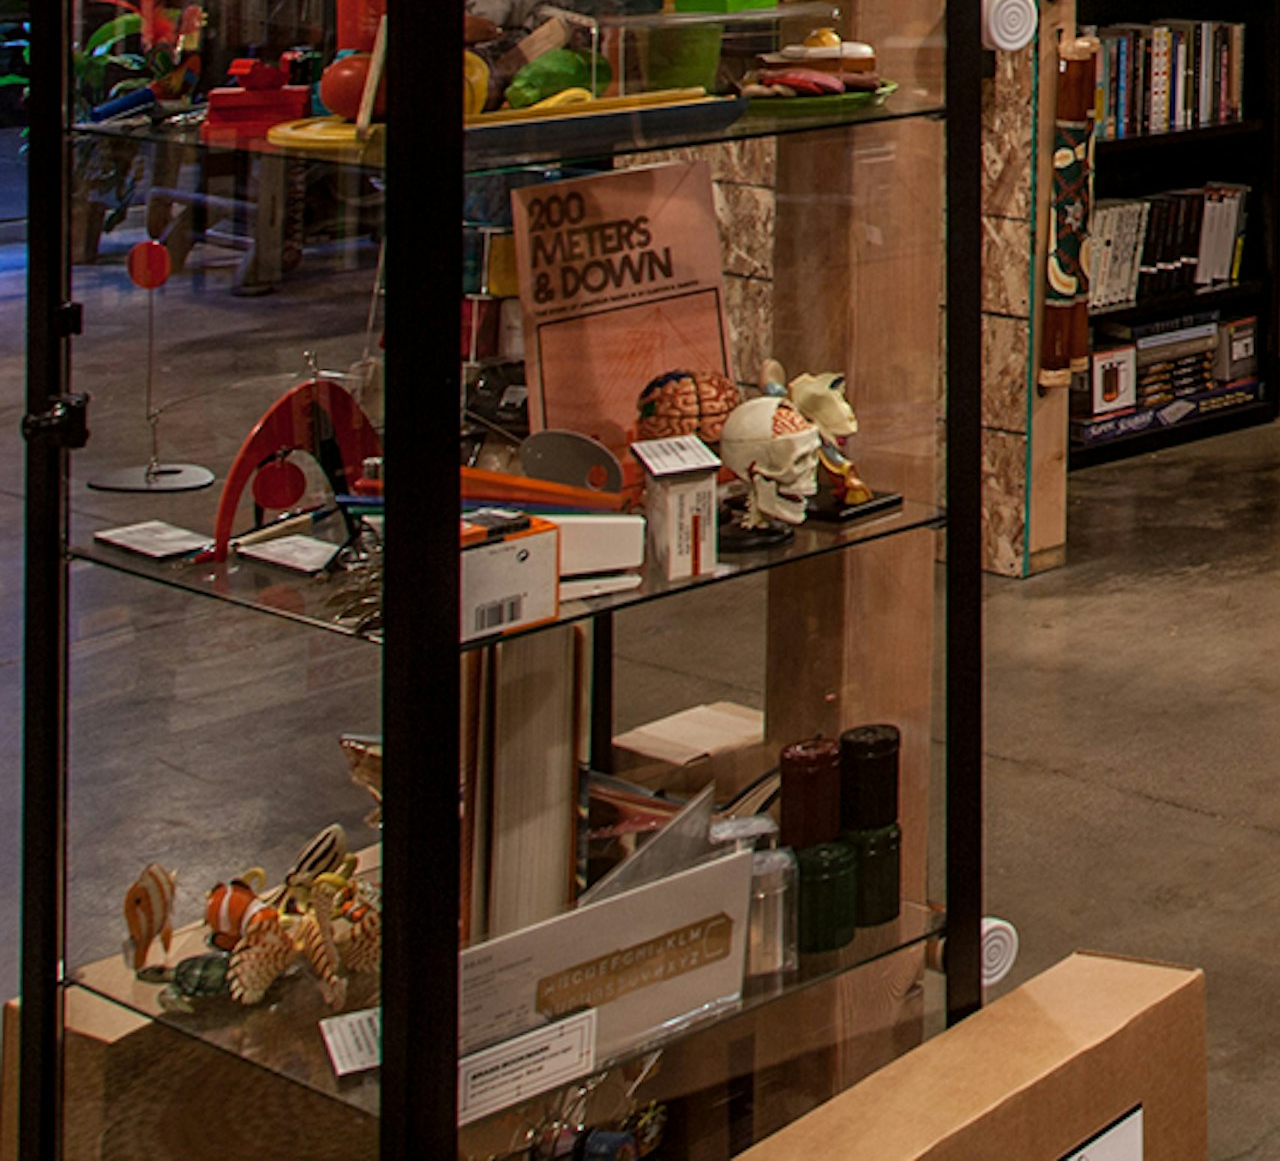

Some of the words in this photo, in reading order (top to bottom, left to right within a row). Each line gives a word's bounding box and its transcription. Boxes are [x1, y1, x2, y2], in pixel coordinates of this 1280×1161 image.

[528, 191, 585, 233] 200
[531, 215, 652, 269] METERS
[533, 272, 555, 304] &
[560, 247, 673, 300] DOWN
[471, 1064, 501, 1081] BRASS
